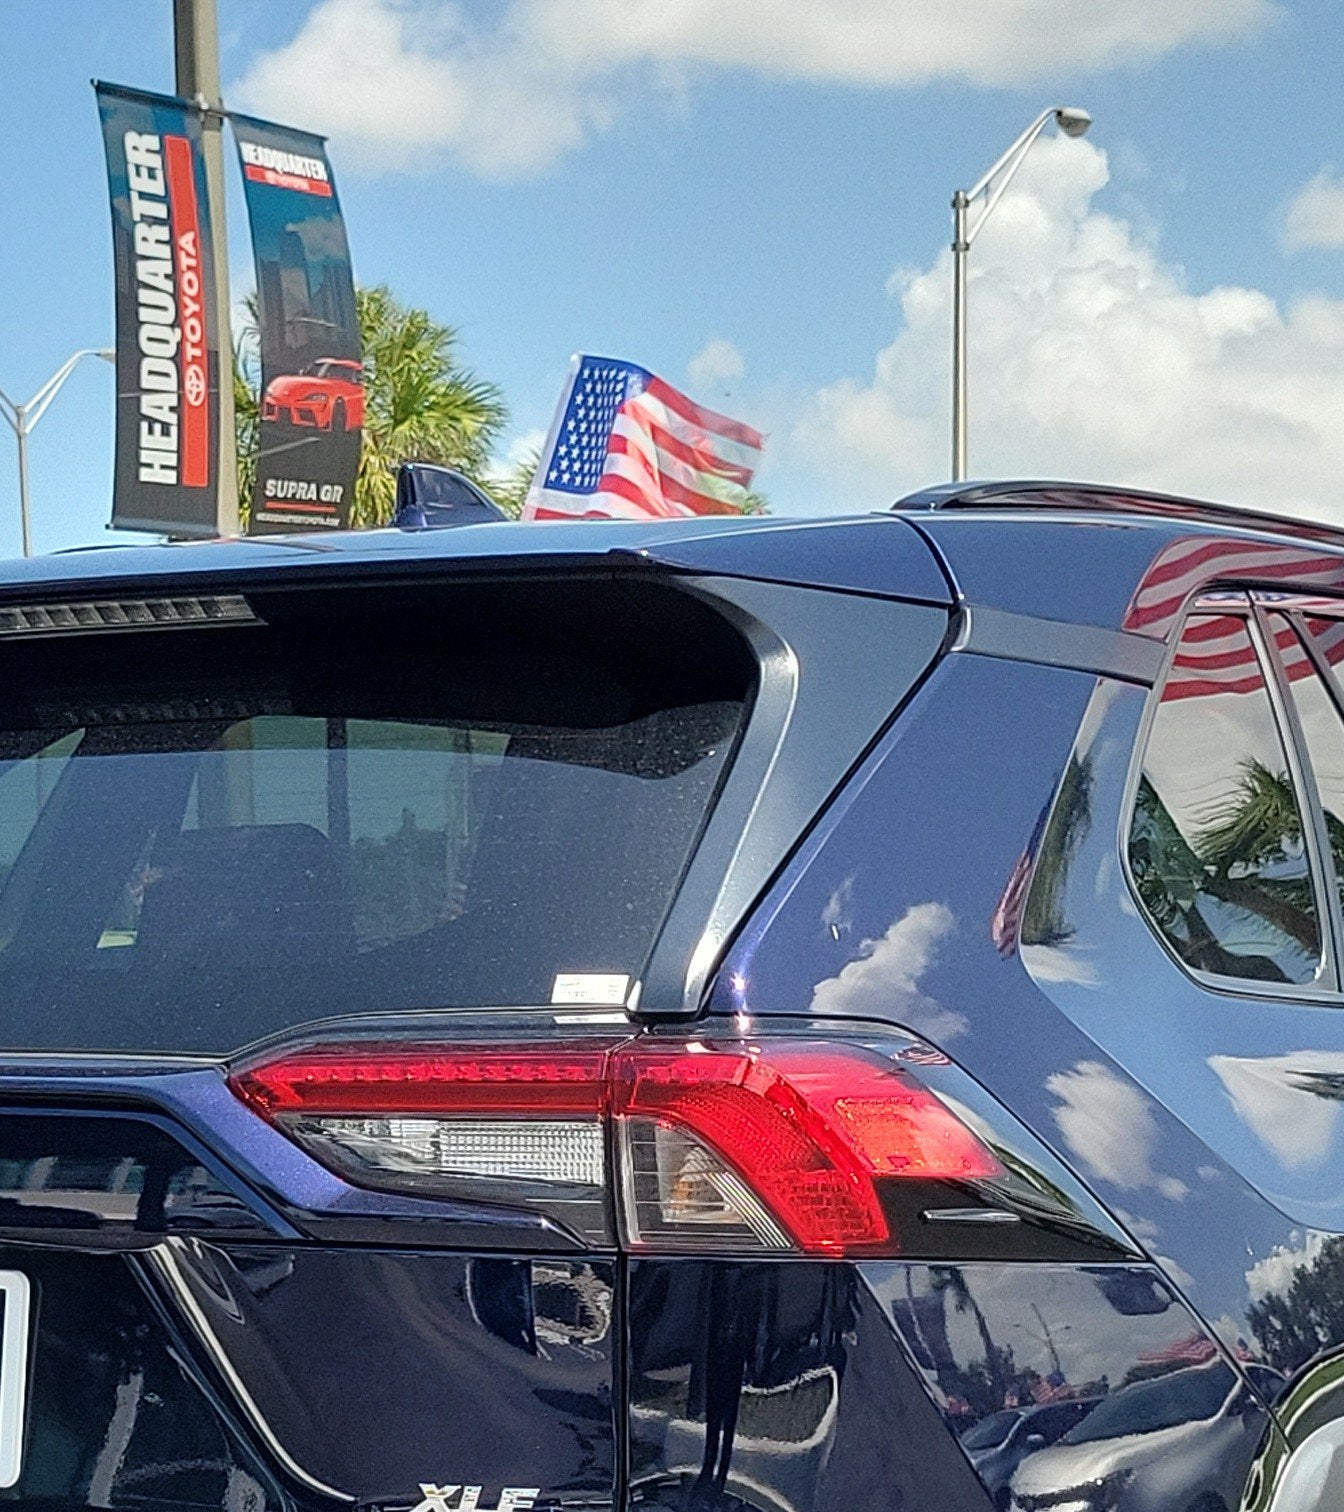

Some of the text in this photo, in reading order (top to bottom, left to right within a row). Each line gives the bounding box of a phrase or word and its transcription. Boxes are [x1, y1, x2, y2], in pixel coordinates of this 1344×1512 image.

[124, 131, 181, 485] HEADQUARTER
[179, 231, 203, 362] TOYOTA
[265, 479, 343, 503] SUPRA GR
